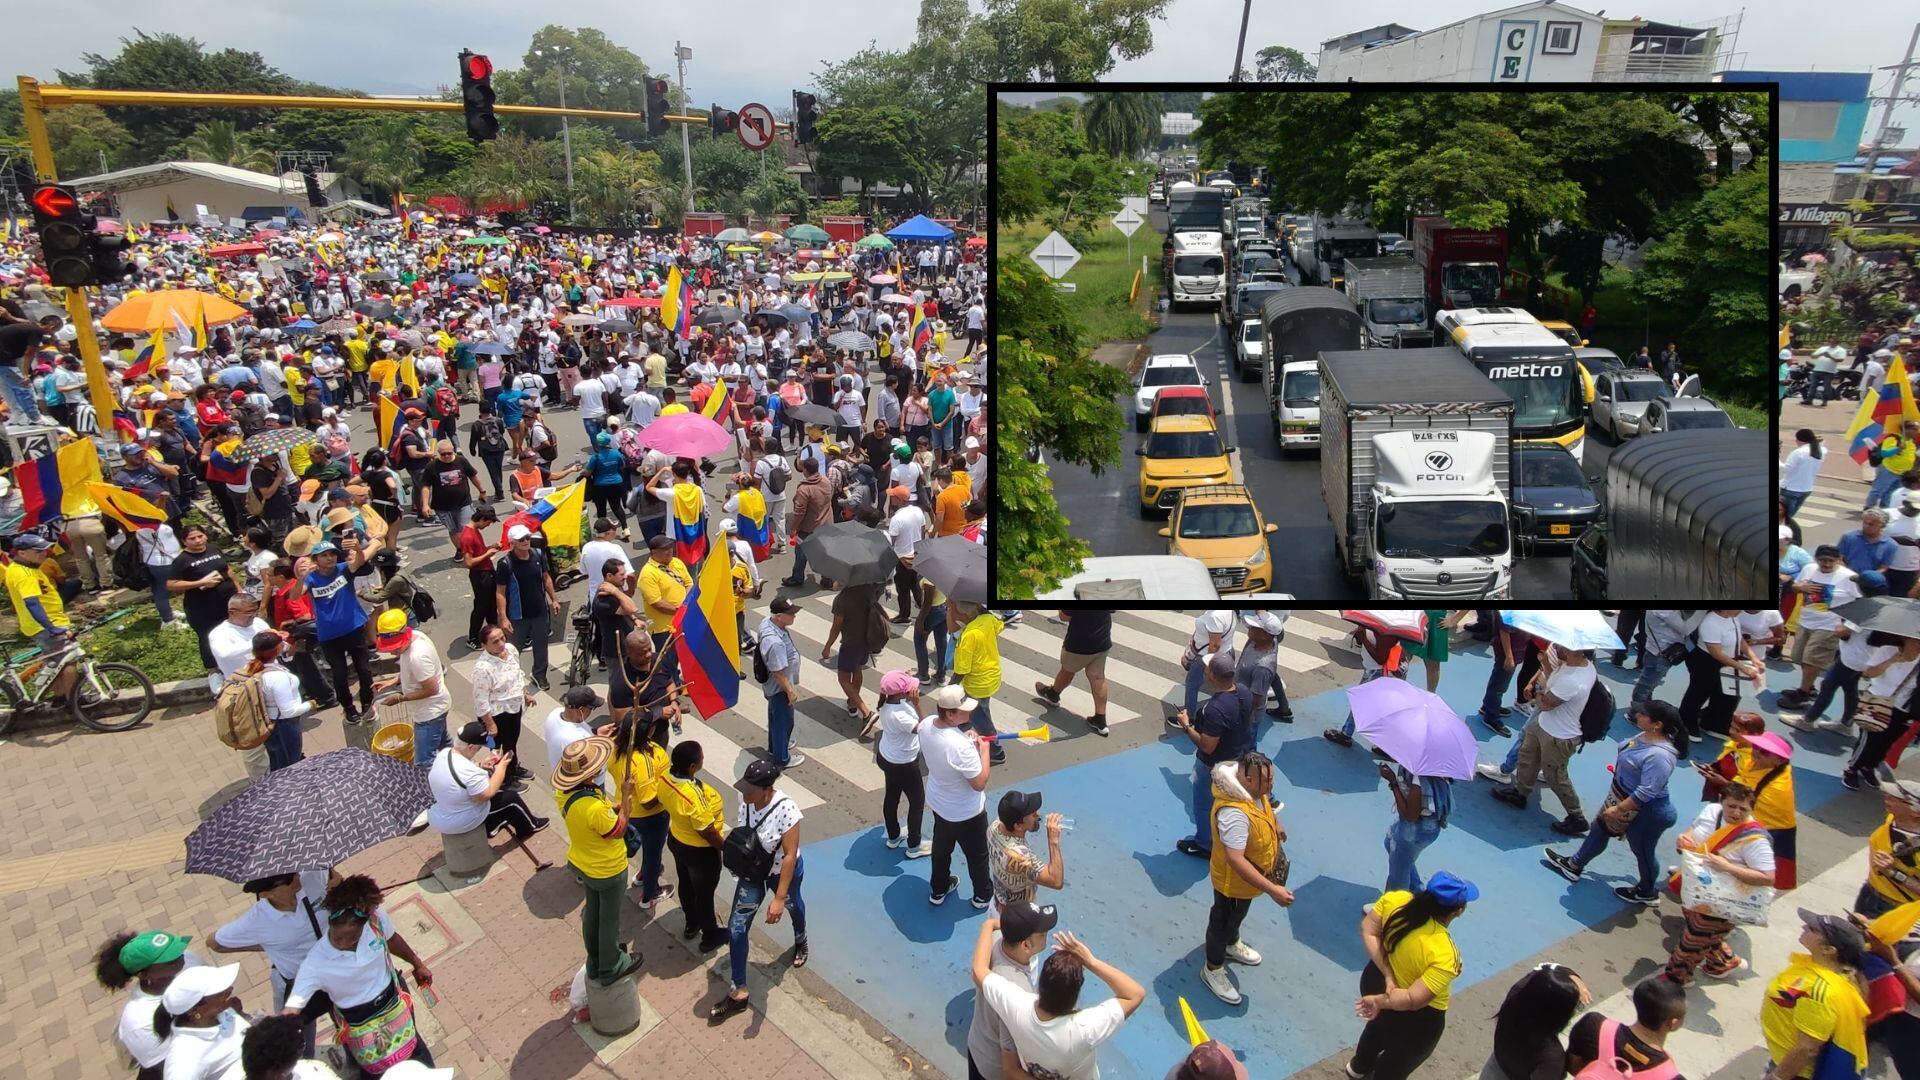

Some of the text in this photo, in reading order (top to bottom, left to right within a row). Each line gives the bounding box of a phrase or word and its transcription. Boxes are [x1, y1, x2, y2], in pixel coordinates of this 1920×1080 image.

[1792, 206, 1863, 225] Milagroa
[1488, 363, 1563, 379] mettro
[1416, 473, 1465, 482] FOTON
